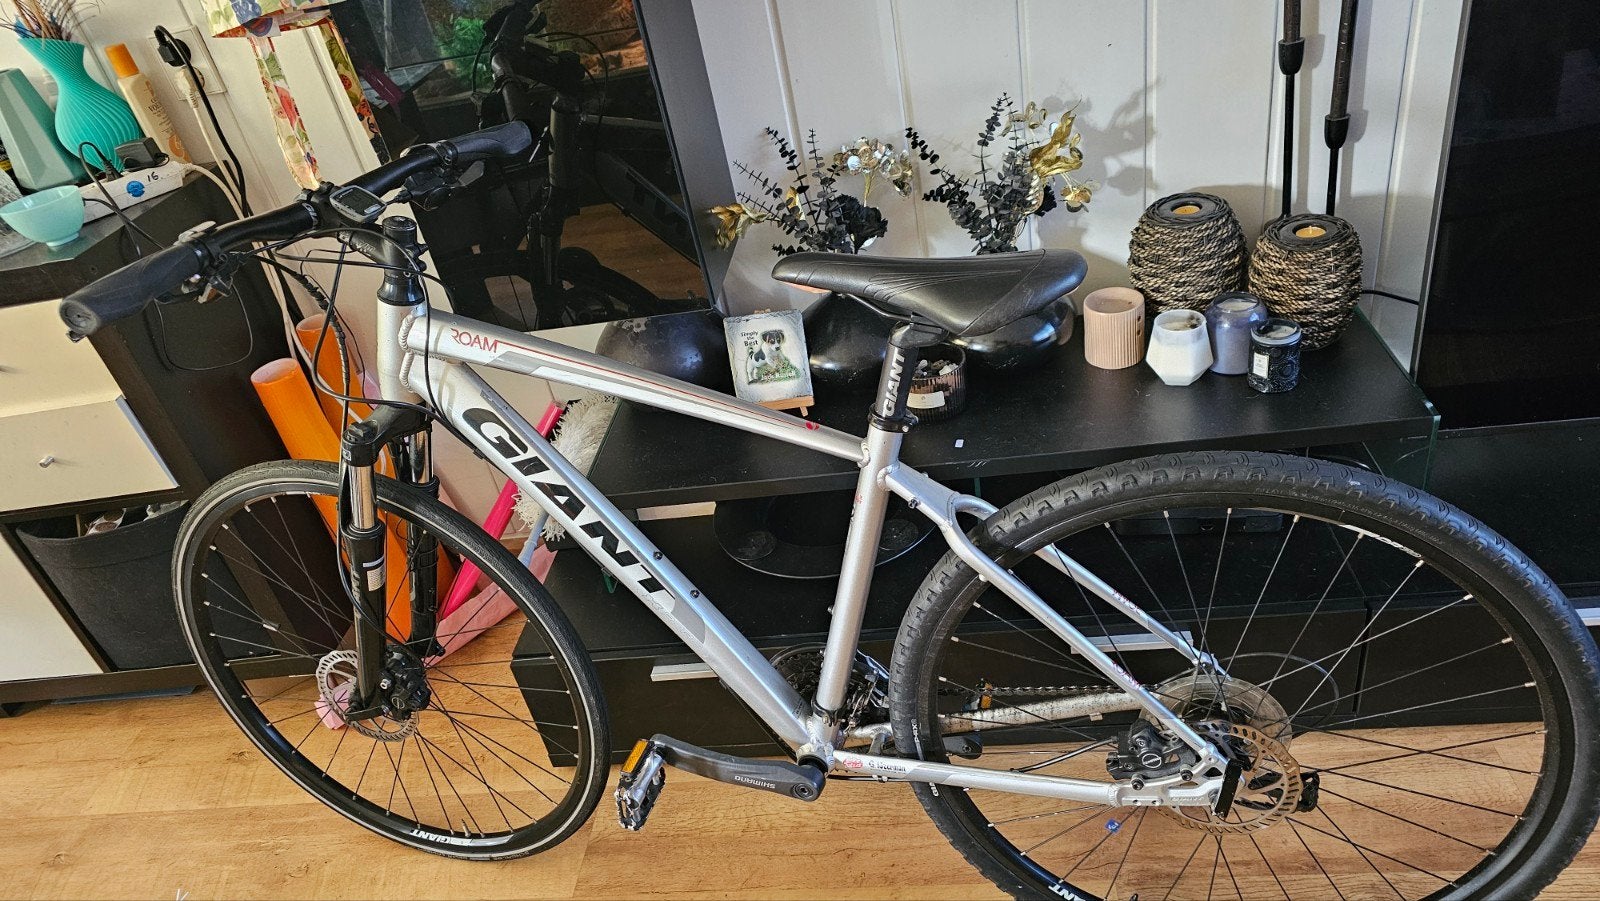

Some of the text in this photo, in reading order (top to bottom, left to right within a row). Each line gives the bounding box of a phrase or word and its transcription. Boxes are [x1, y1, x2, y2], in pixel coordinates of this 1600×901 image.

[147, 171, 159, 182] 16
[450, 327, 498, 354] ROAM
[882, 346, 906, 418] GIANT
[462, 407, 676, 600] GIANT
[734, 775, 776, 789] SHIMANO
[410, 828, 451, 844] GIANT
[1048, 883, 1086, 901] ANT
